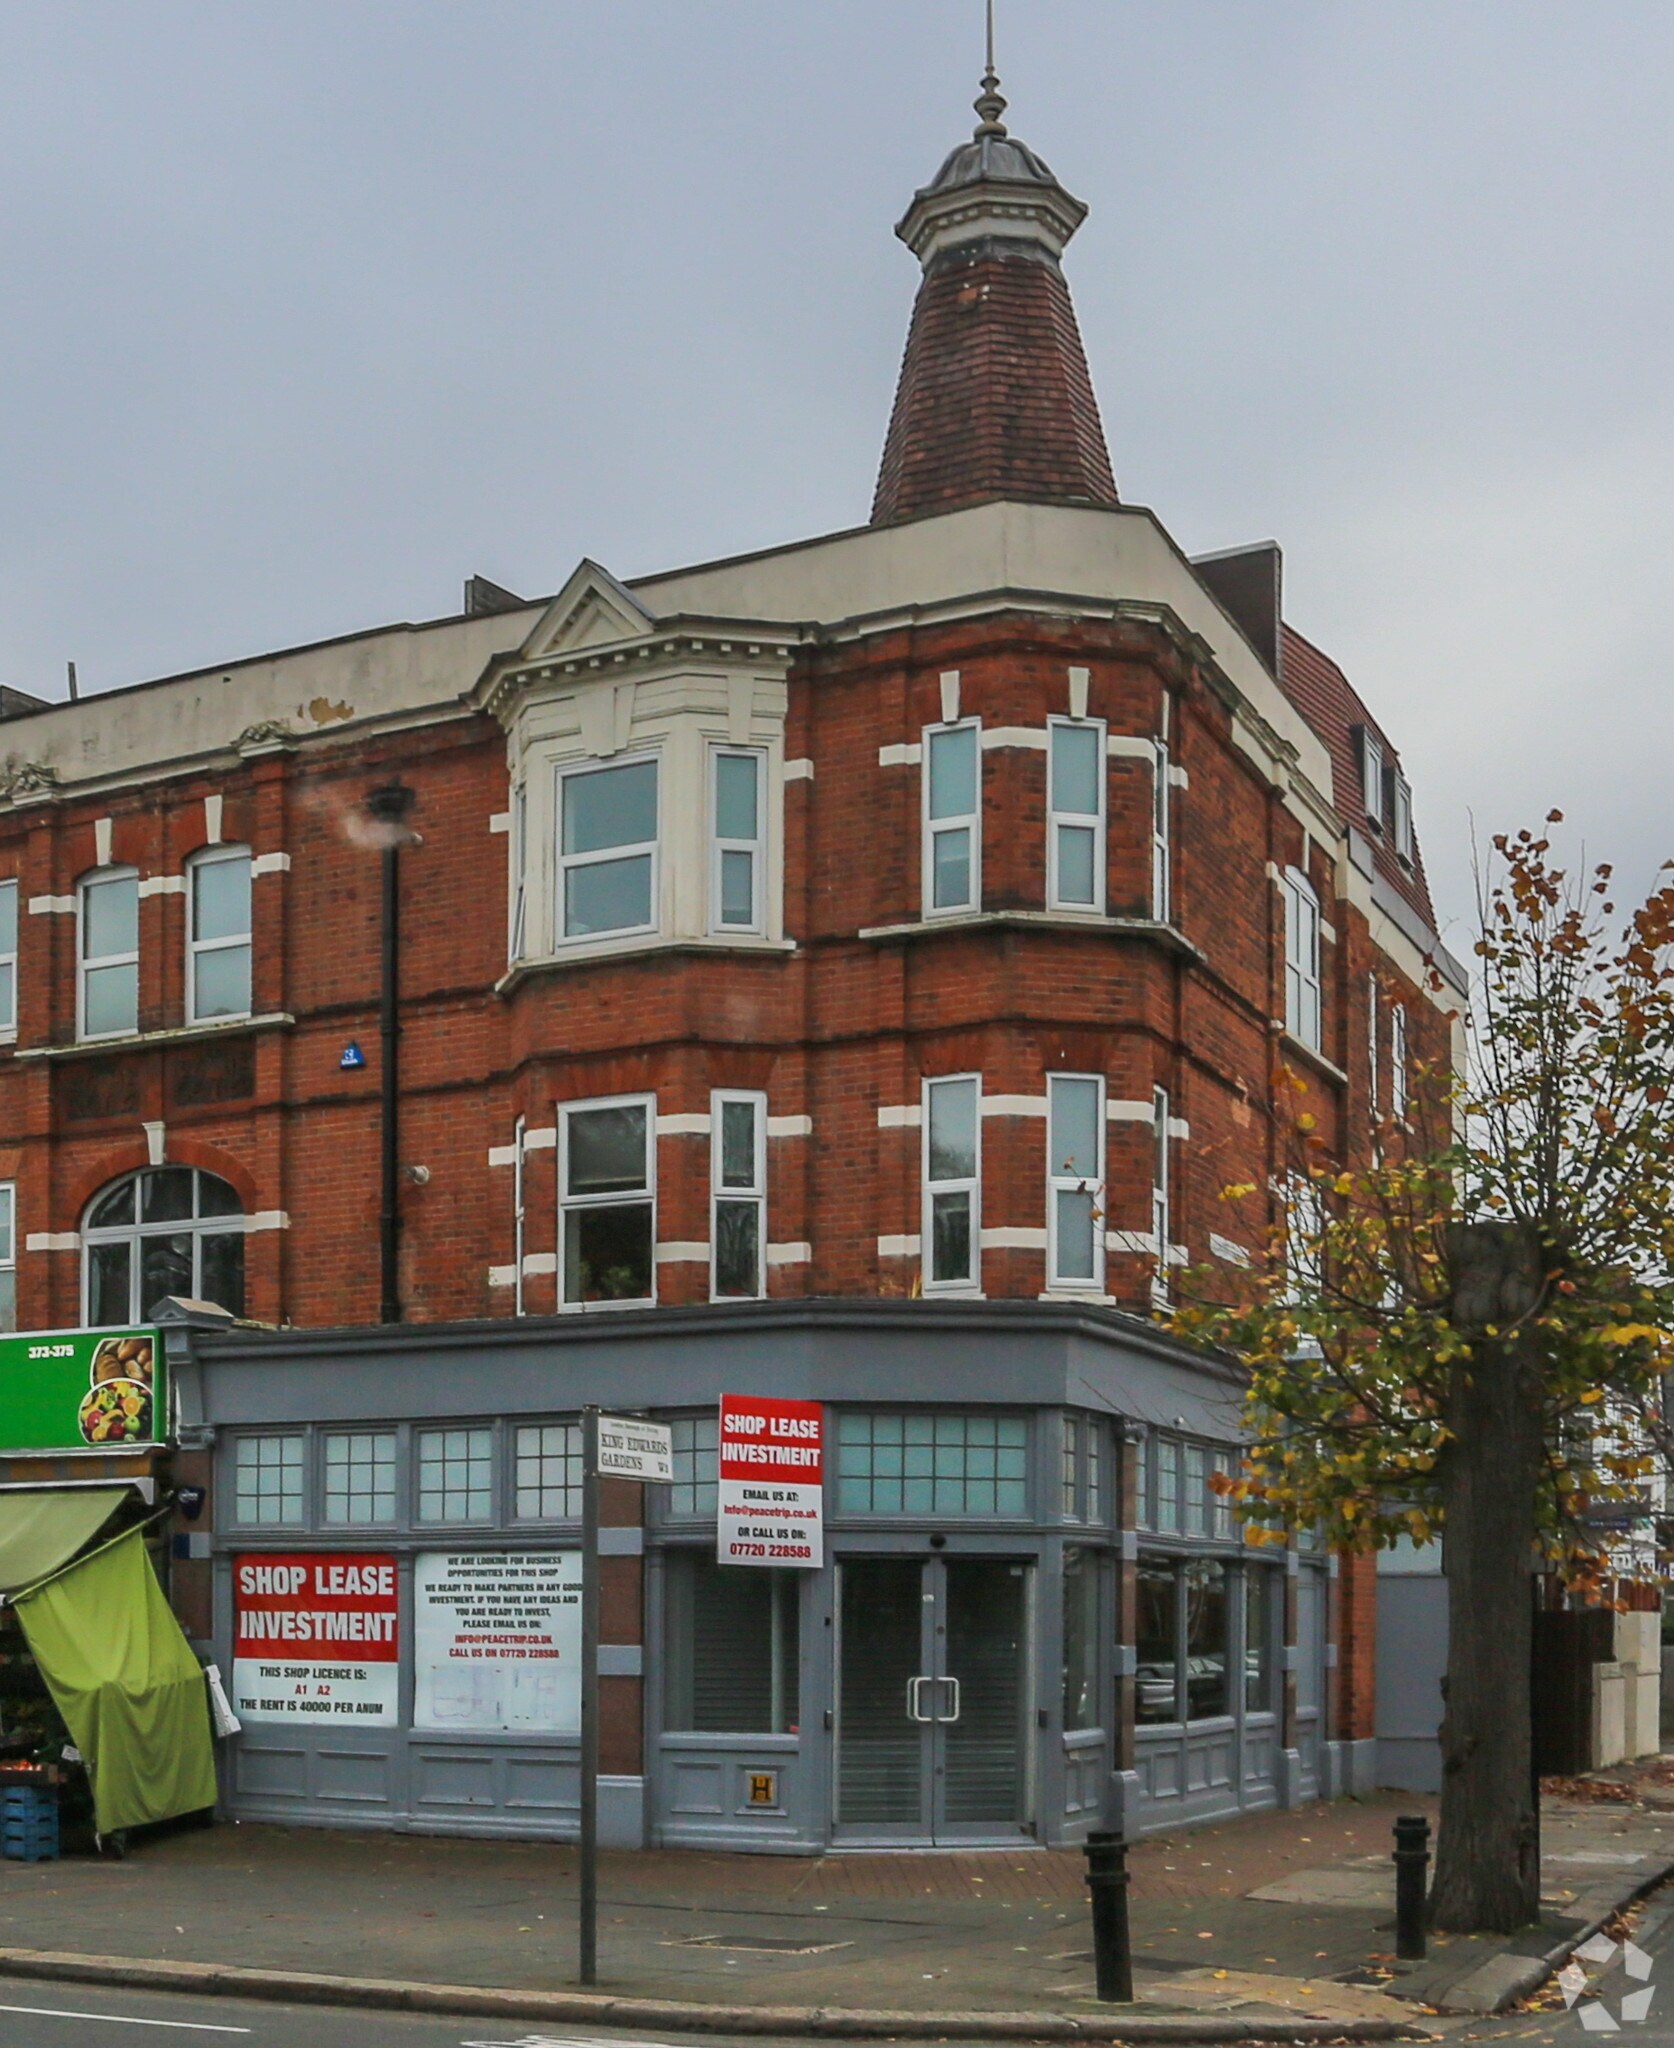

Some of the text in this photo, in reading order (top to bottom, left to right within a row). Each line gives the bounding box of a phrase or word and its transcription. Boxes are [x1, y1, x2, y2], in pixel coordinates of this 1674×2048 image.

[29, 1344, 75, 1359] 373-375
[724, 1414, 819, 1439] SHOP LEASE
[601, 1433, 668, 1455] KING EDWARDS
[601, 1453, 643, 1470] GARDENS
[722, 1442, 820, 1467] INVESTMENT
[743, 1489, 799, 1502] EMAIL US AT:
[738, 1527, 806, 1540] OR CALL US ON:
[730, 1543, 811, 1558] 07720 228588
[448, 1556, 562, 1566] WE ARE LOOKING FOR BUSINESS
[448, 1568, 558, 1578] OPPORTUNITIES FOR THIS SHOP
[240, 1566, 394, 1596] SHOP LEASE
[425, 1584, 436, 1592] WE
[438, 1584, 461, 1592] READY
[464, 1584, 472, 1592] TO
[475, 1584, 496, 1592] MAKE
[498, 1584, 534, 1592] PARTNERS
[537, 1584, 544, 1592] IN
[546, 1584, 560, 1592] ANY
[478, 1596, 485, 1604] IF
[487, 1596, 501, 1604] YOU
[503, 1596, 521, 1604] HAVE
[523, 1596, 538, 1604] ANY
[540, 1596, 561, 1604] IDEAS
[563, 1596, 578, 1604] AND
[455, 1608, 470, 1616] YOU
[471, 1608, 486, 1616] ARE
[488, 1608, 512, 1616] READY
[514, 1608, 523, 1616] TO
[240, 1610, 397, 1641] INVESTMENT
[463, 1620, 542, 1628] PLEASE EMAIL US ON:
[449, 1648, 469, 1658] CALL
[472, 1648, 482, 1658] US
[486, 1648, 497, 1658] ON
[500, 1648, 526, 1658] 07720
[260, 1666, 367, 1680] THIS SHOP LICENCE IS:
[295, 1684, 331, 1696] A1 A2
[240, 1699, 383, 1714] THE RENT IS 40000 PER ANUM
[751, 1775, 771, 1802] H
